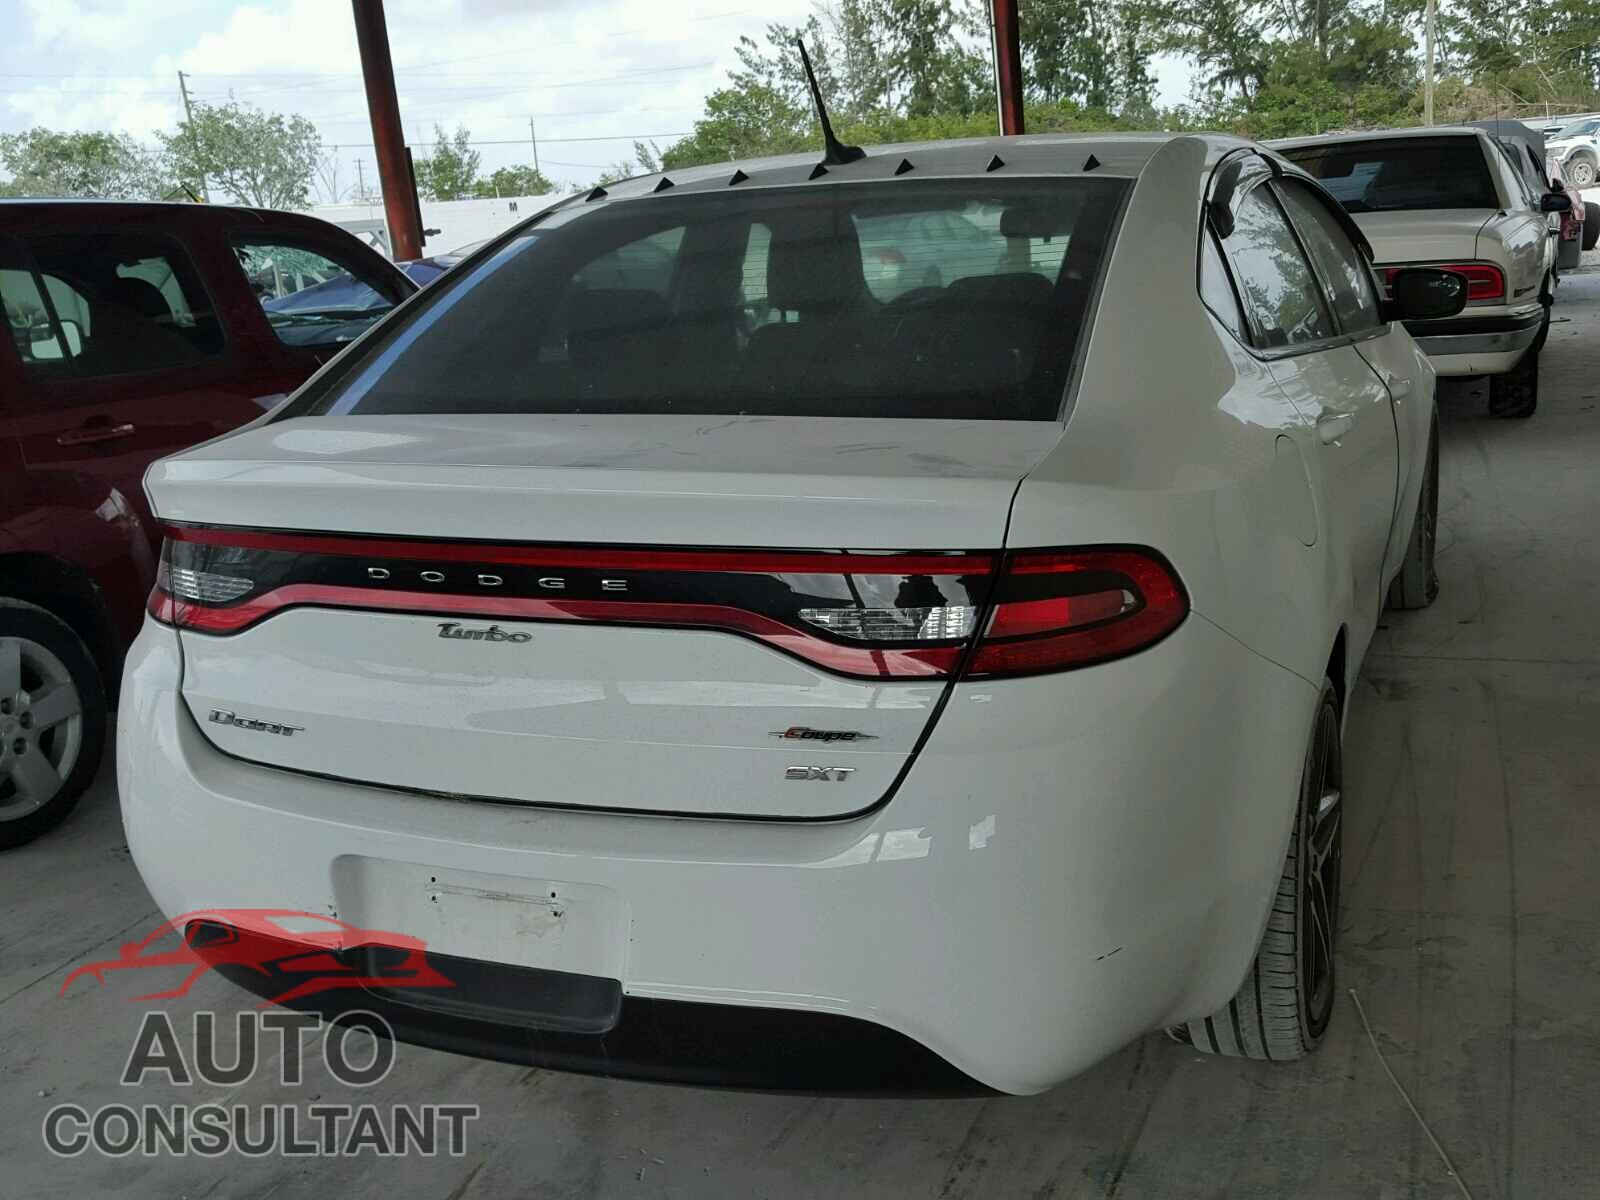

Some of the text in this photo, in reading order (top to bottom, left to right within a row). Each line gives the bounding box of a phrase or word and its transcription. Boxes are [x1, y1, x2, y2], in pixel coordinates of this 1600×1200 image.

[367, 567, 628, 591] DODGE
[437, 622, 532, 643] Turbo
[783, 726, 863, 743] Coupe
[784, 766, 856, 781] SXT
